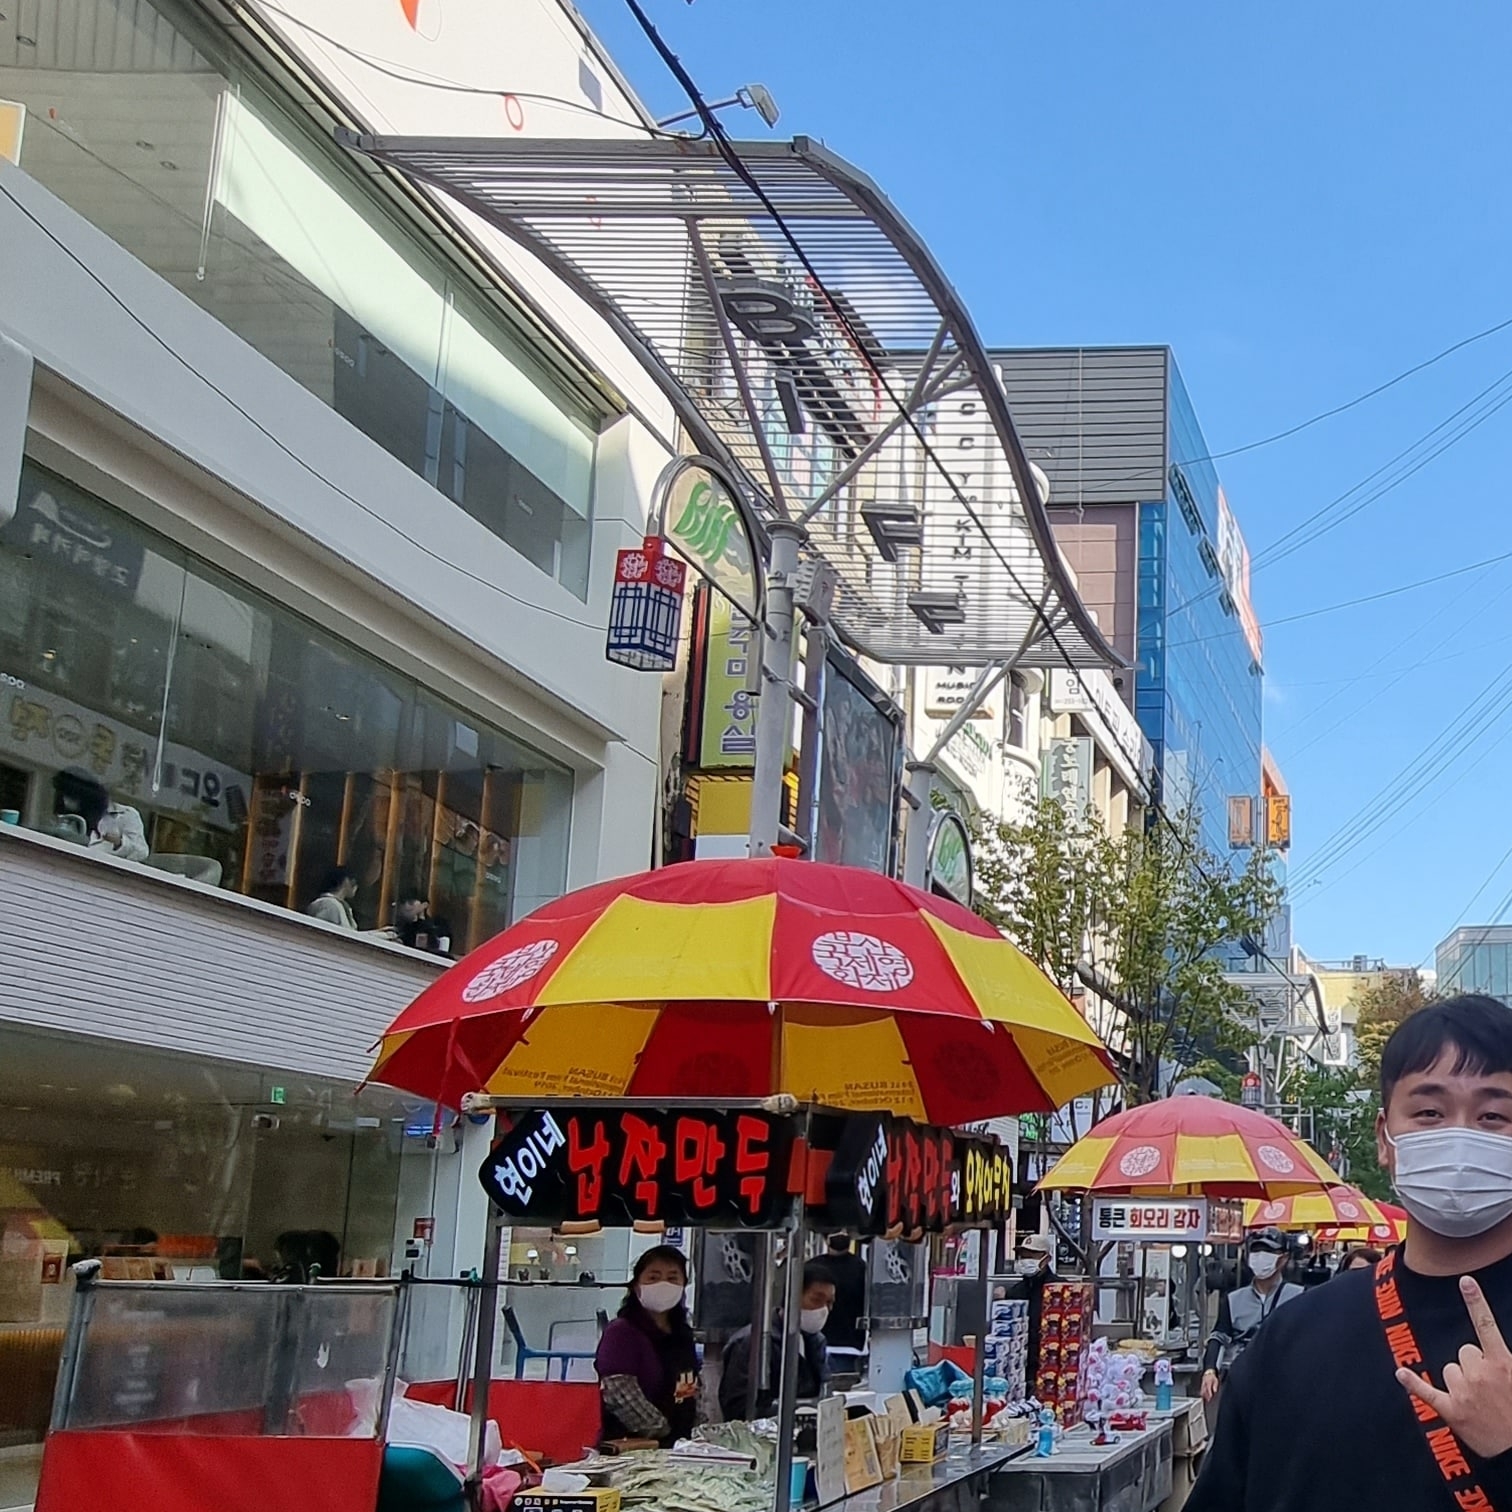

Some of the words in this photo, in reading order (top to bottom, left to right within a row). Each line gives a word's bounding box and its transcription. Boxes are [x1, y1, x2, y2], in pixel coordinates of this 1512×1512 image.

[935, 695, 976, 705] ROO
[493, 1110, 567, 1207] 현이네
[567, 1110, 772, 1217] 납작만두
[857, 1122, 889, 1216] 현이네
[886, 1128, 954, 1226] 납작만두
[1098, 1206, 1127, 1229] 통큰
[1129, 1206, 1170, 1229] 회오리
[1173, 1206, 1201, 1229] 감자
[1375, 1277, 1404, 1321] NIKE
[1384, 1321, 1424, 1370] NIKE
[1425, 1426, 1472, 1481] NIKE
